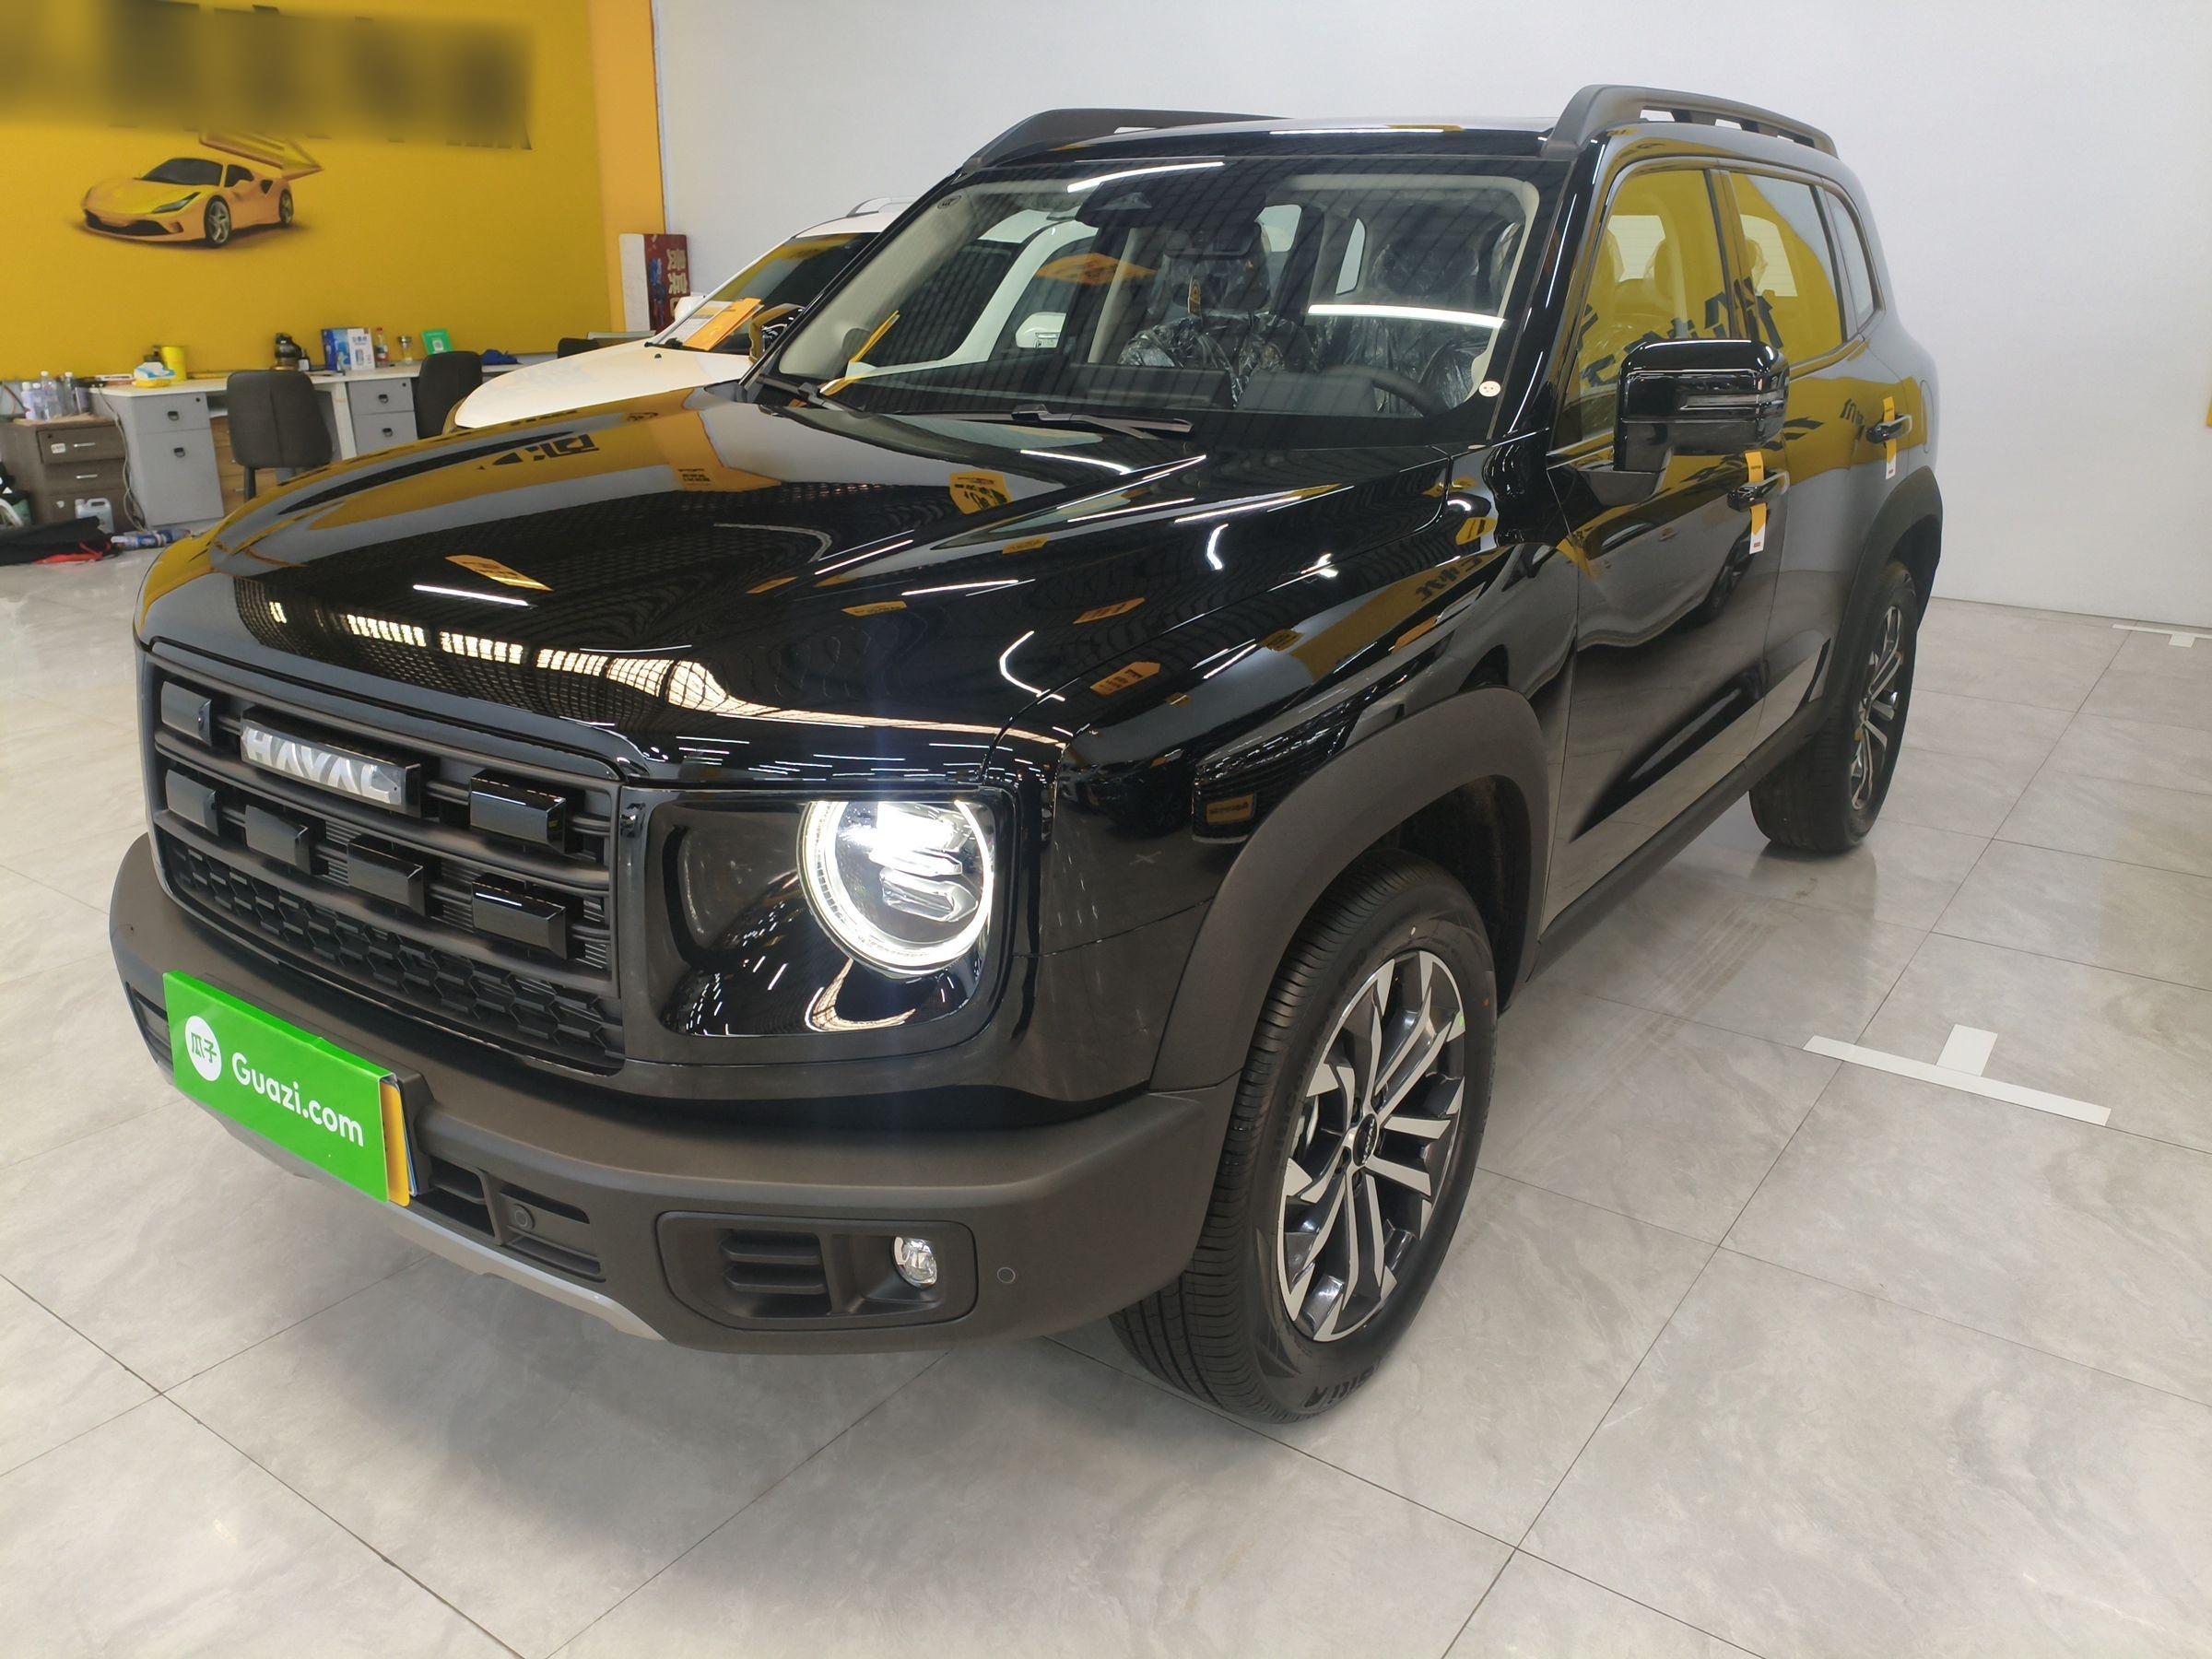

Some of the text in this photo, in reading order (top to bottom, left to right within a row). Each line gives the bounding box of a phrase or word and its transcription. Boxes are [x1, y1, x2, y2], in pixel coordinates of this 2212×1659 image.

[244, 725, 391, 805] HAVAL
[191, 1031, 218, 1064] 瓜子
[231, 1052, 364, 1147] Guazi.com
